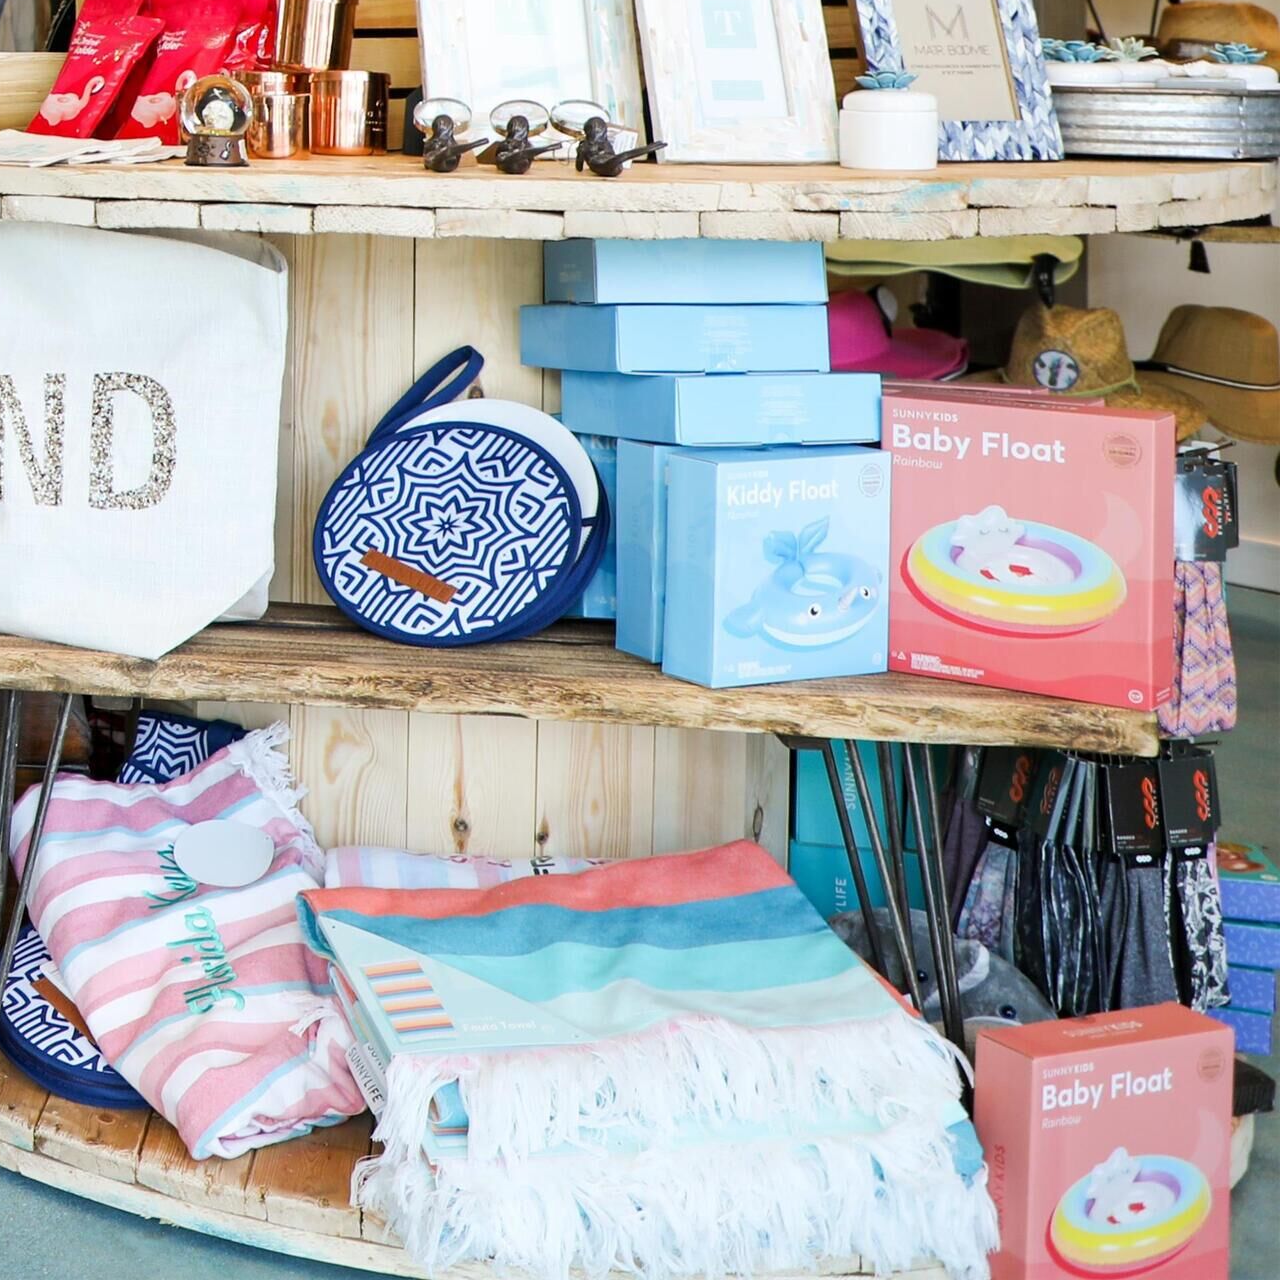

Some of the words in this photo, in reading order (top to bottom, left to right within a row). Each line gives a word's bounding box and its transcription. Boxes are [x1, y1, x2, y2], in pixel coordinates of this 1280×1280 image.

[891, 407, 959, 423] SUNNYKIDS
[892, 423, 971, 460] Baby
[981, 430, 1067, 465] Float
[892, 453, 944, 471] Rainbow
[726, 481, 784, 510] Kiddy
[789, 478, 840, 504] Float
[1041, 1079, 1105, 1111] Baby
[1110, 1066, 1174, 1100] Float
[1041, 1114, 1083, 1130] Rainbow
